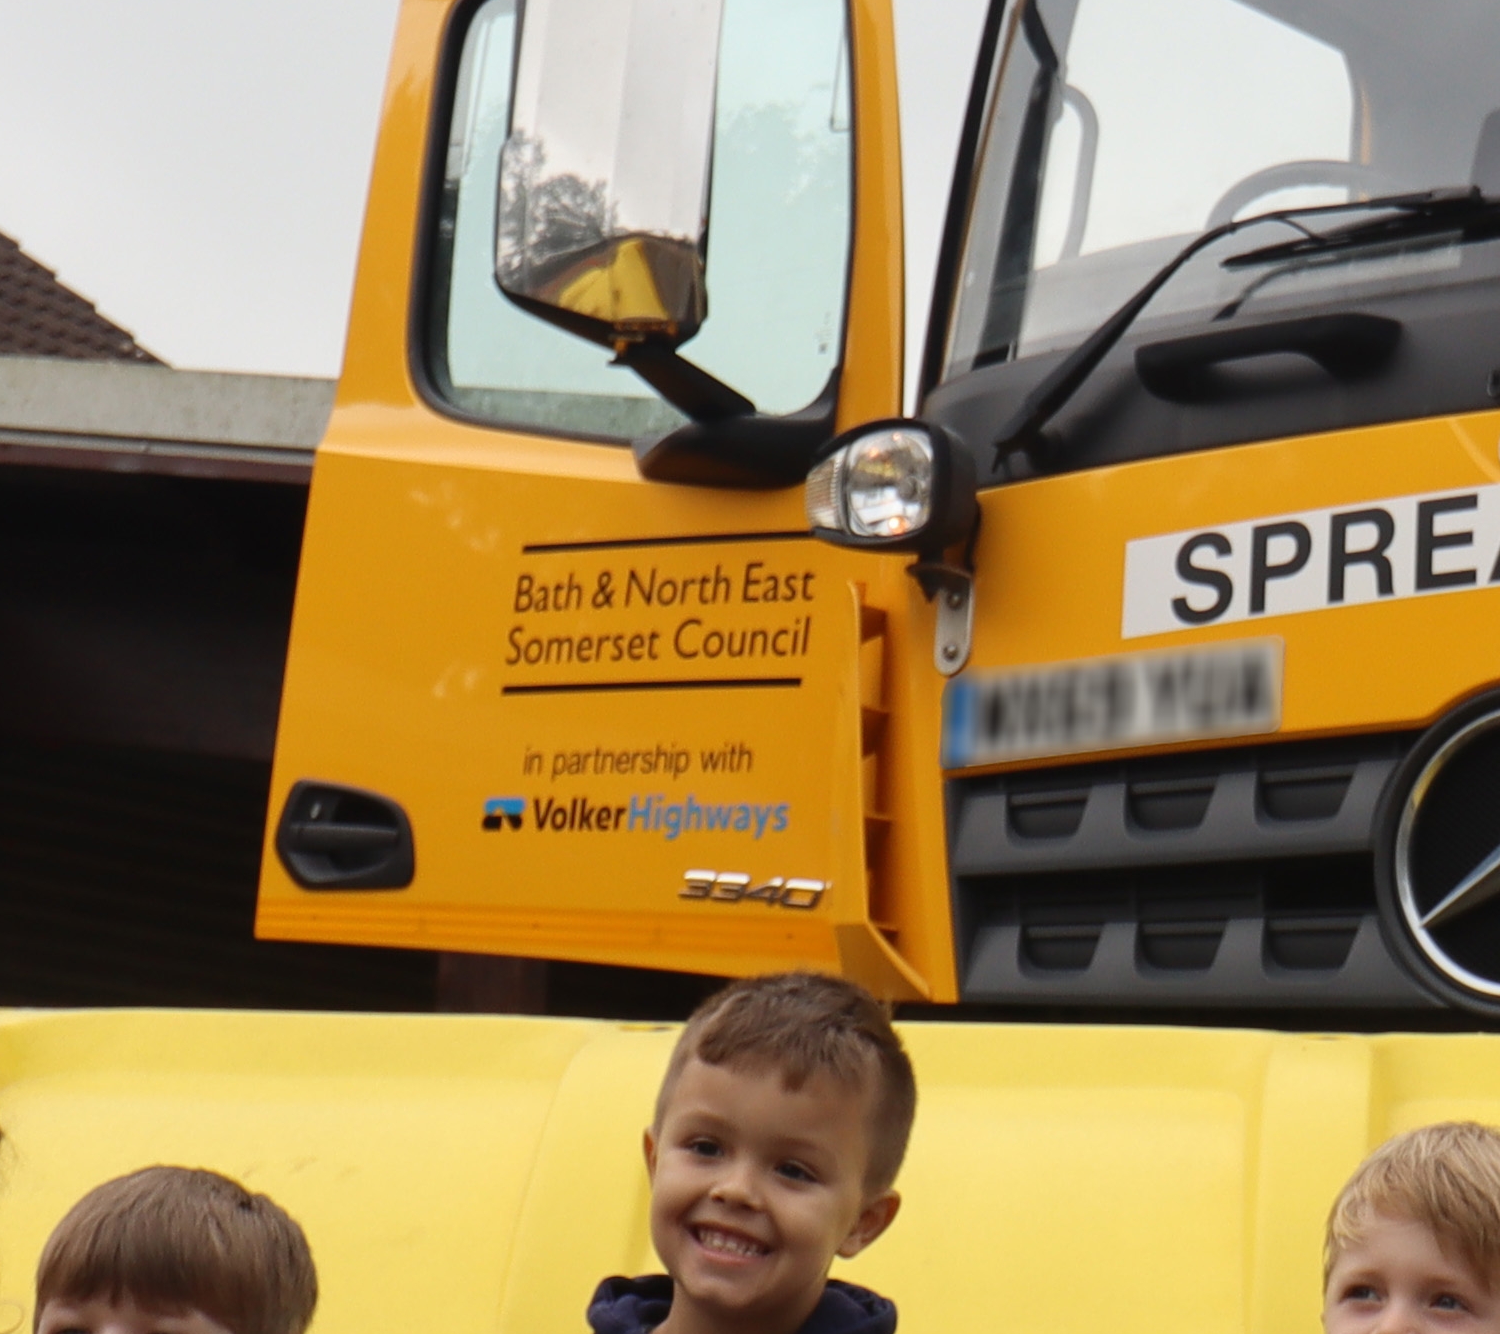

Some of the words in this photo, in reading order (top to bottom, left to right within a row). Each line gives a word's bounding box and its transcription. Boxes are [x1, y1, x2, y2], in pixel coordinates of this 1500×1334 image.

[513, 568, 583, 614] Bath
[591, 571, 617, 609] &
[624, 563, 732, 608] North
[741, 560, 817, 604] East
[505, 623, 660, 667] Somerset
[672, 616, 810, 660] Council
[522, 748, 544, 776] in
[551, 745, 690, 782] partnership
[699, 743, 754, 772] with
[532, 794, 790, 840] VolkerHighways
[678, 868, 826, 909] 3340
